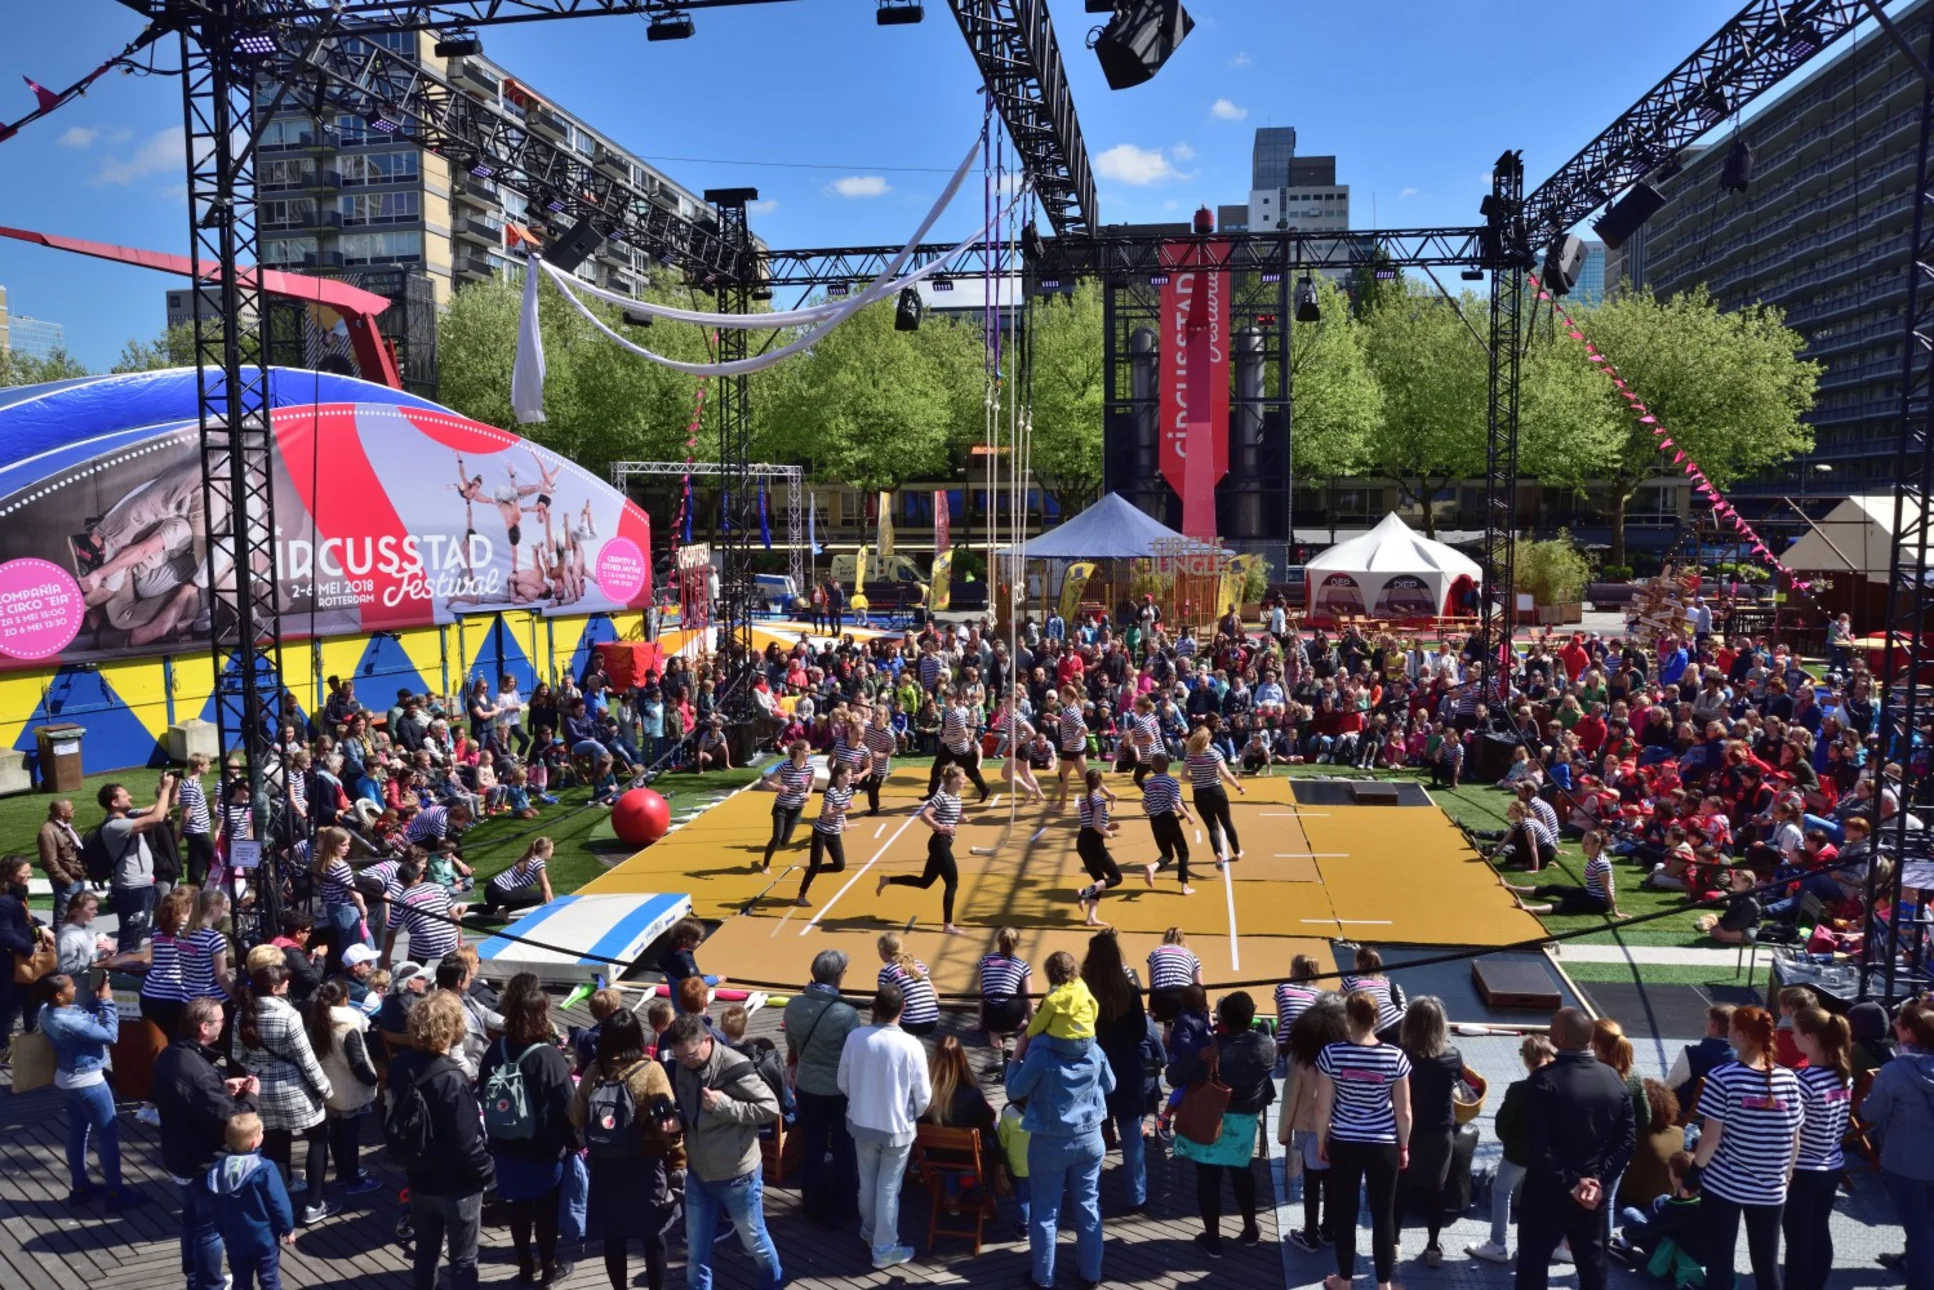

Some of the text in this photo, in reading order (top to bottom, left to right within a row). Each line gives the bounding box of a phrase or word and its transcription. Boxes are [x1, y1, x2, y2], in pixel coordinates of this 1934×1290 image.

[1152, 536, 1225, 555] CIRCUS
[1147, 556, 1226, 576] JUNGLE
[318, 581, 340, 595] MEI
[344, 579, 374, 593] 2018
[383, 568, 499, 607] Festival
[1331, 578, 1350, 587] DIEP
[1394, 580, 1417, 589] DIEP
[0, 583, 61, 604] OMPAÑÍA
[318, 594, 375, 607] ROTTERDAM
[7, 599, 42, 614] CIRCO
[23, 613, 38, 622] MEI
[27, 622, 43, 632] MEI
